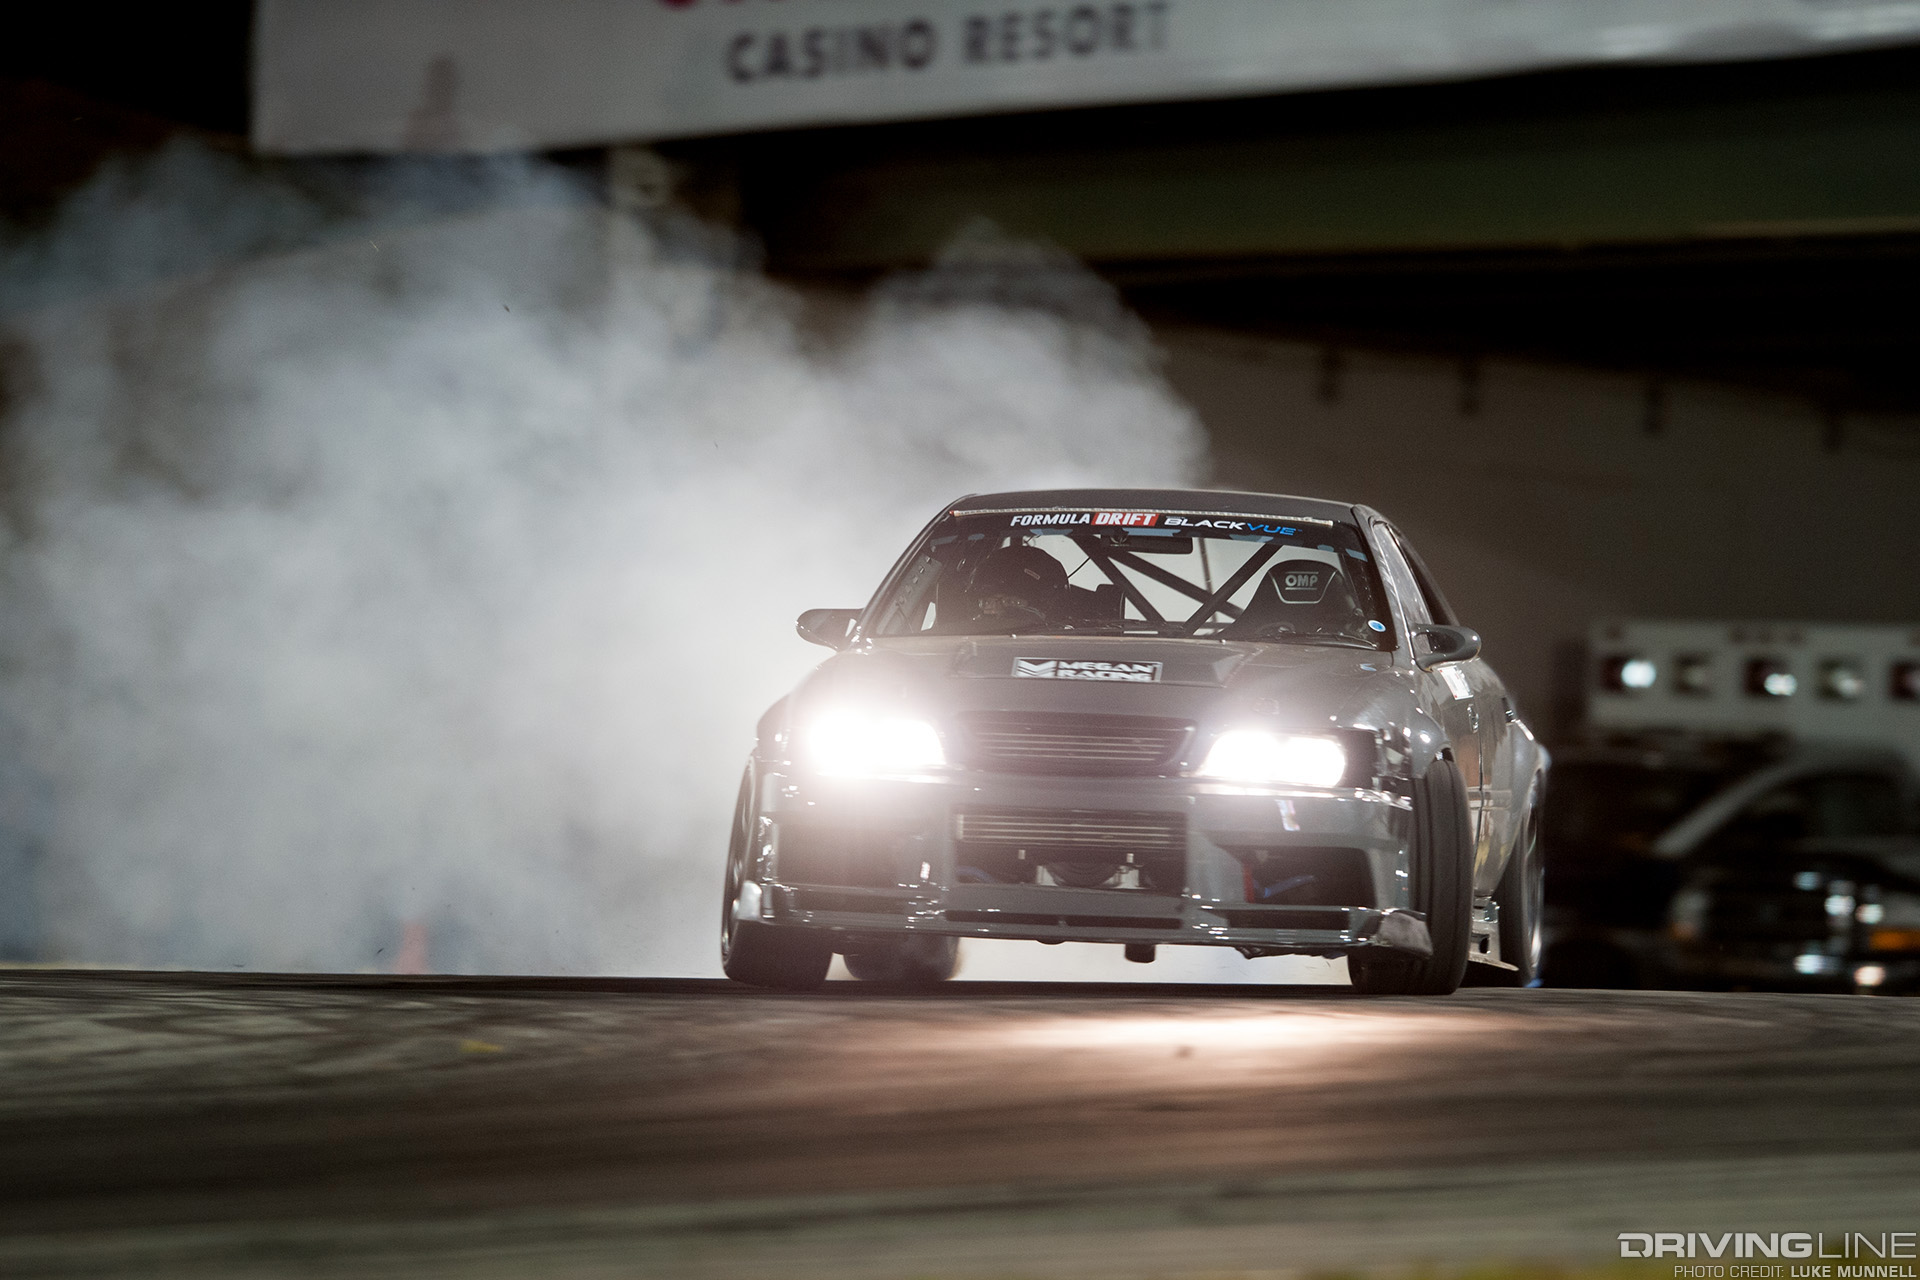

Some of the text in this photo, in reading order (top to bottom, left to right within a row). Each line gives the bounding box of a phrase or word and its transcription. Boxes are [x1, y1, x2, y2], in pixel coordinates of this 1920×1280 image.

[728, 0, 1169, 82] CASINO RESORT
[1010, 512, 1297, 536] FORMULA DRIFT BLACKVUE
[1285, 574, 1318, 587] OMP
[1058, 661, 1153, 673] MEGAN
